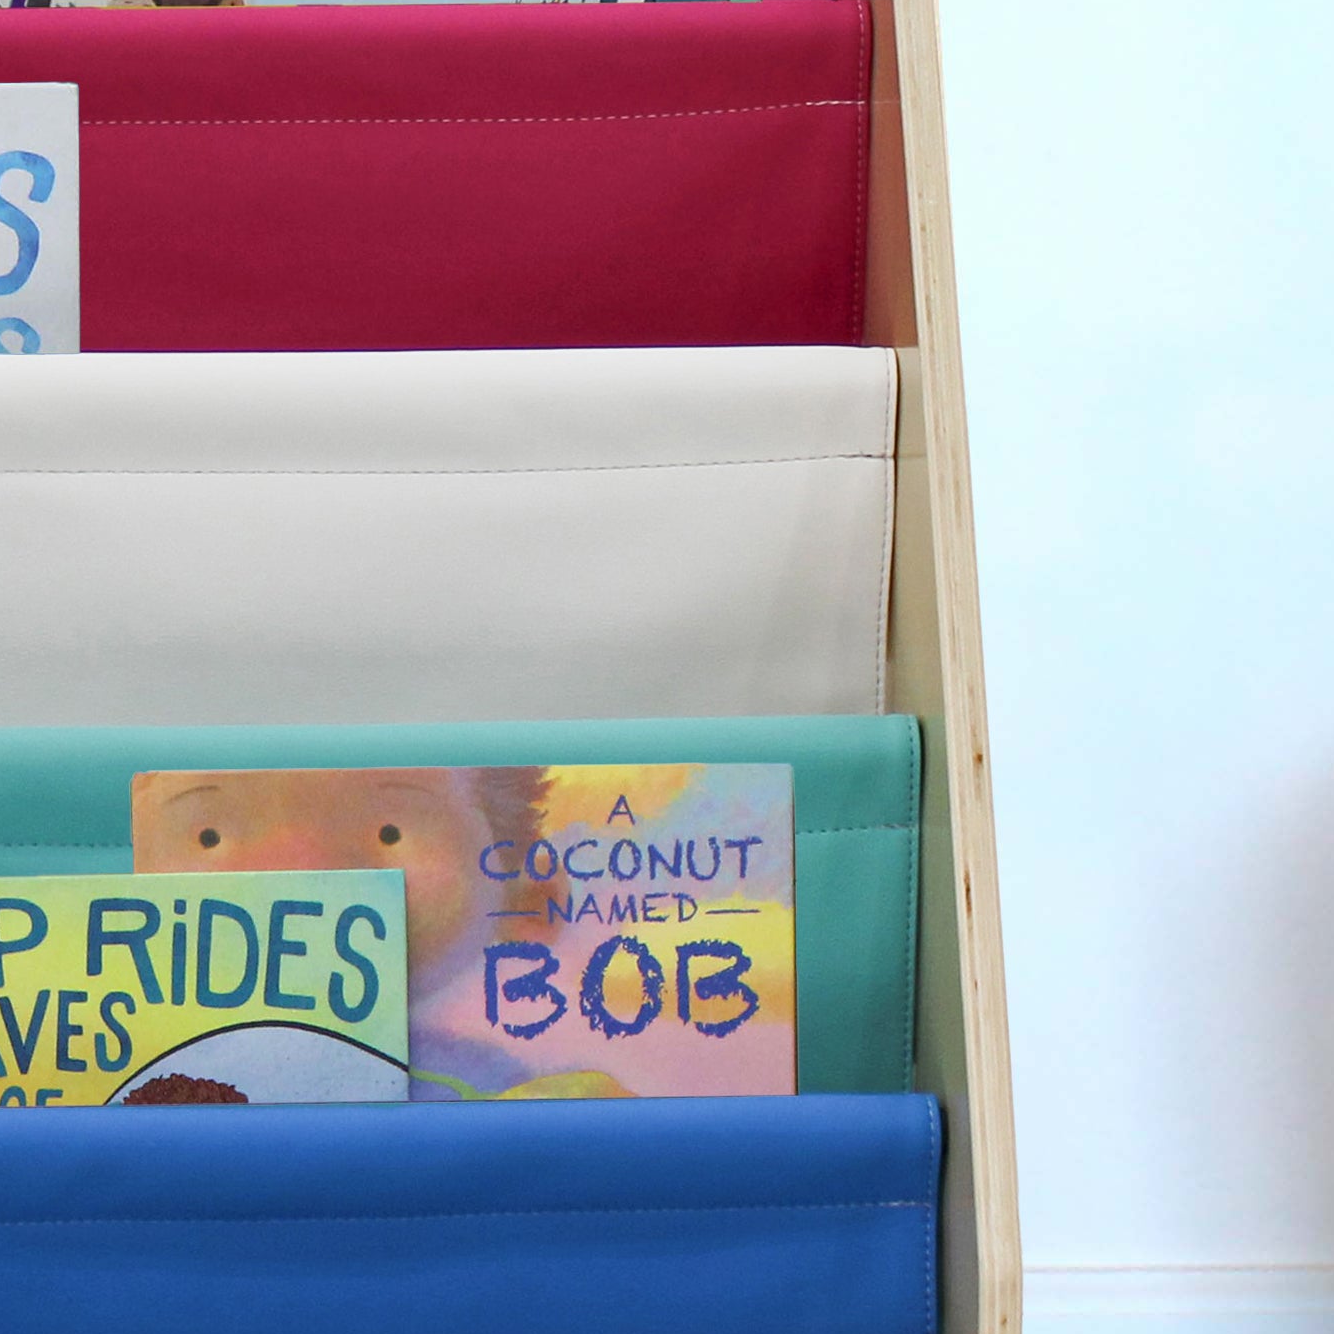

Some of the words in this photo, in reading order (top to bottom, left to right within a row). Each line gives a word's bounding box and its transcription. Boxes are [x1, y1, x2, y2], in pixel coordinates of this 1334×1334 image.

[607, 795, 636, 825] A
[478, 836, 763, 882] COCONUT
[546, 892, 699, 926] NAMED
[482, 934, 760, 1040] BOB
